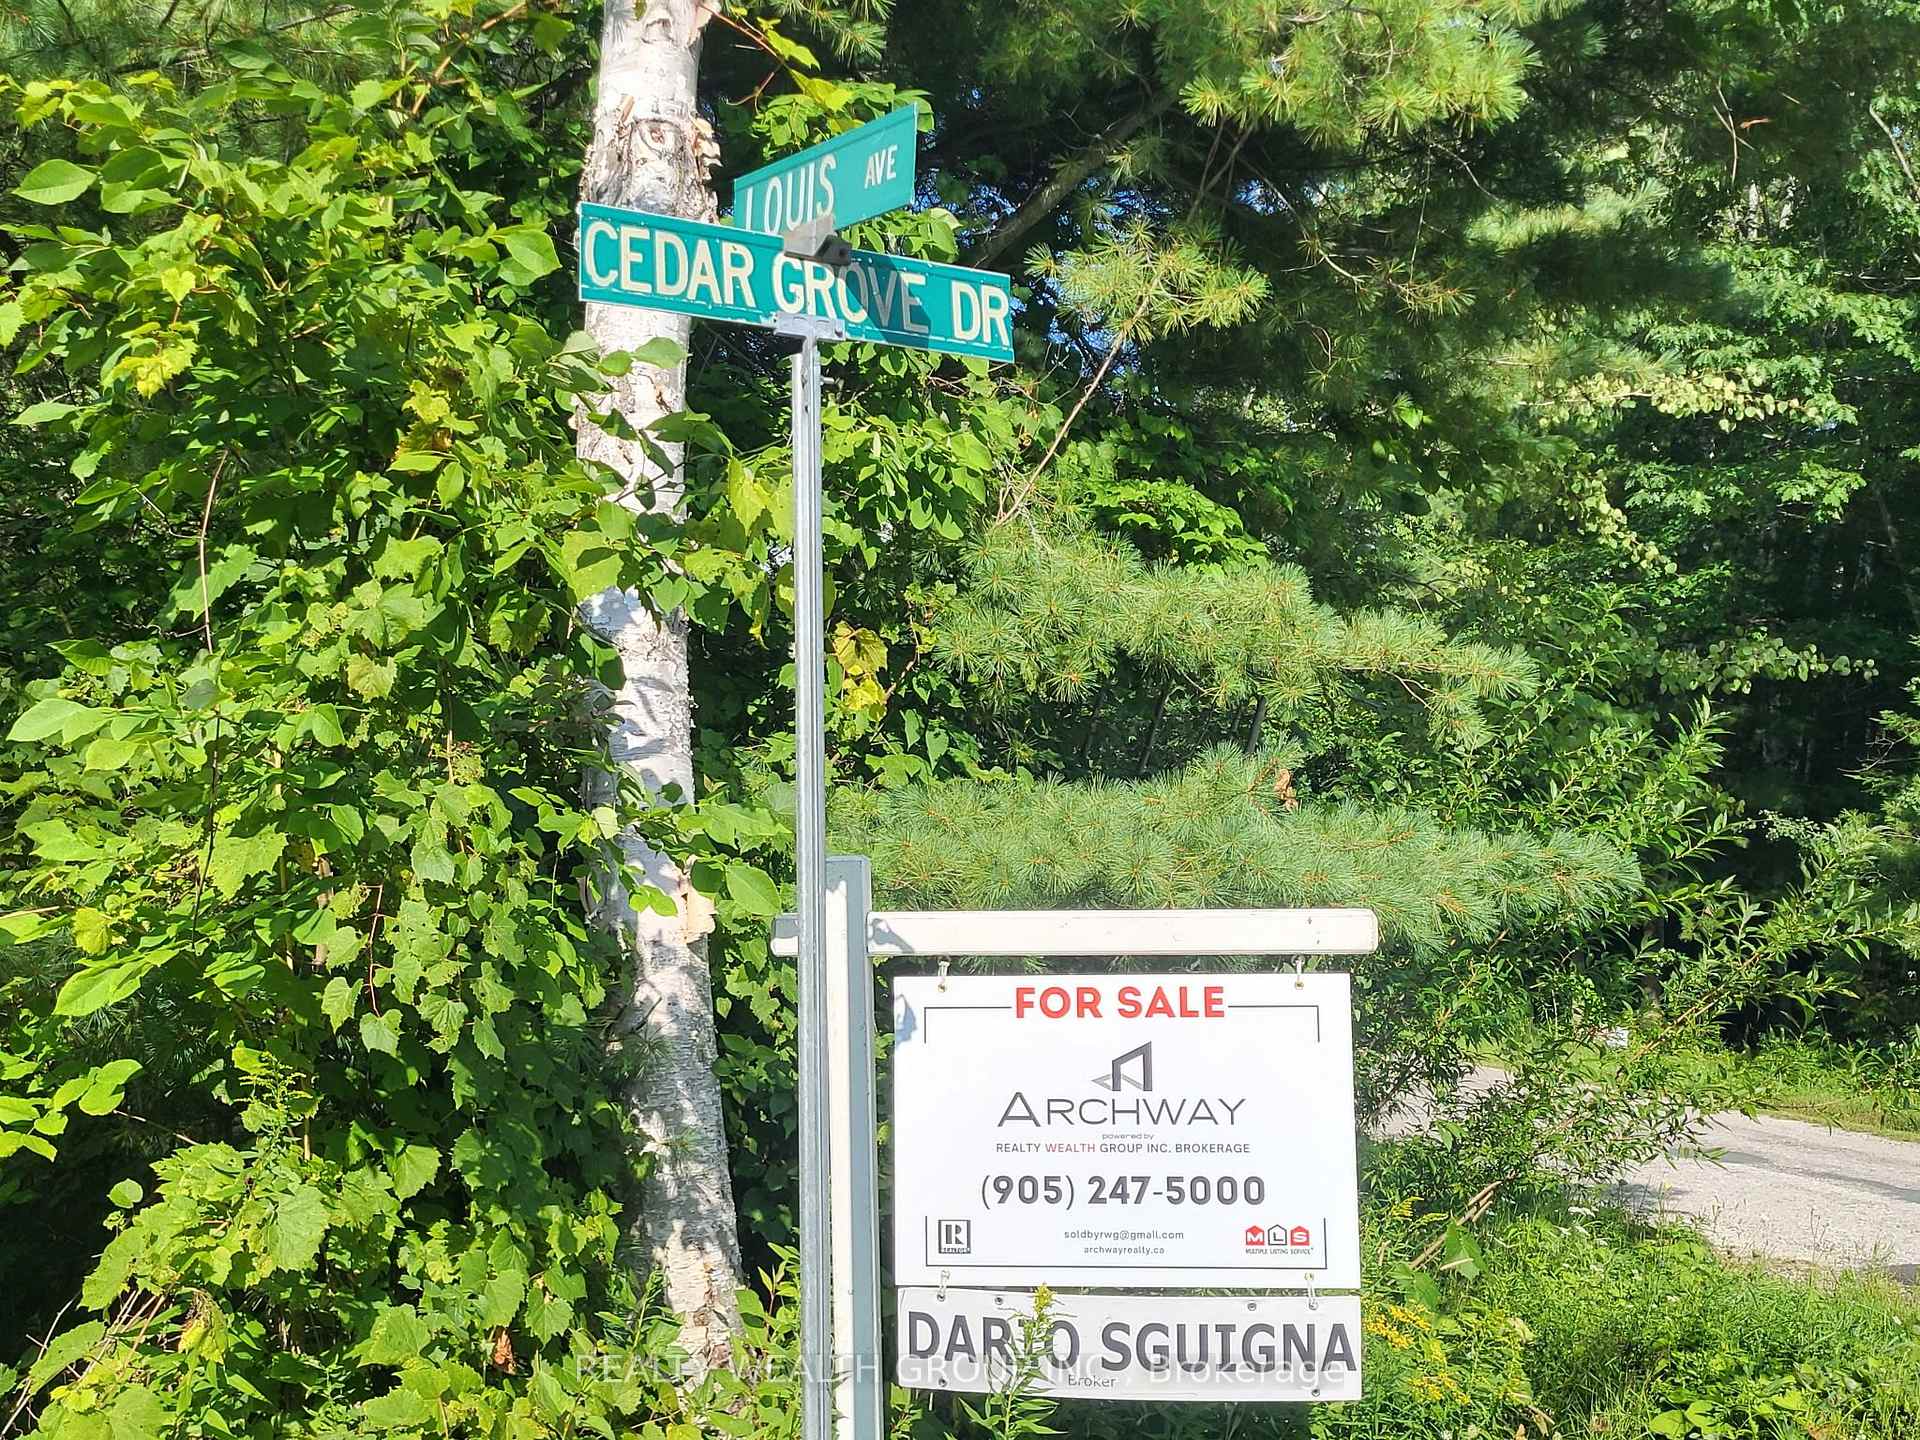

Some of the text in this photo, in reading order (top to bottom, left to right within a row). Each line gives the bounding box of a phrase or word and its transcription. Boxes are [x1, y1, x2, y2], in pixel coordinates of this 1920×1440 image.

[745, 143, 900, 234] LOUIS AVE
[583, 221, 1010, 346] CEDAR GROVE DR
[1015, 986, 1225, 1019] FOR SALE
[997, 1091, 1247, 1127] ARCHWAY
[996, 1143, 1251, 1154] REALTY WEALTH GROUP INC. BROKERAGE
[981, 1175, 1266, 1210] (905) 247-5000
[1101, 1322, 1357, 1374] SGUIGNA
[1068, 1373, 1117, 1388] Broker
